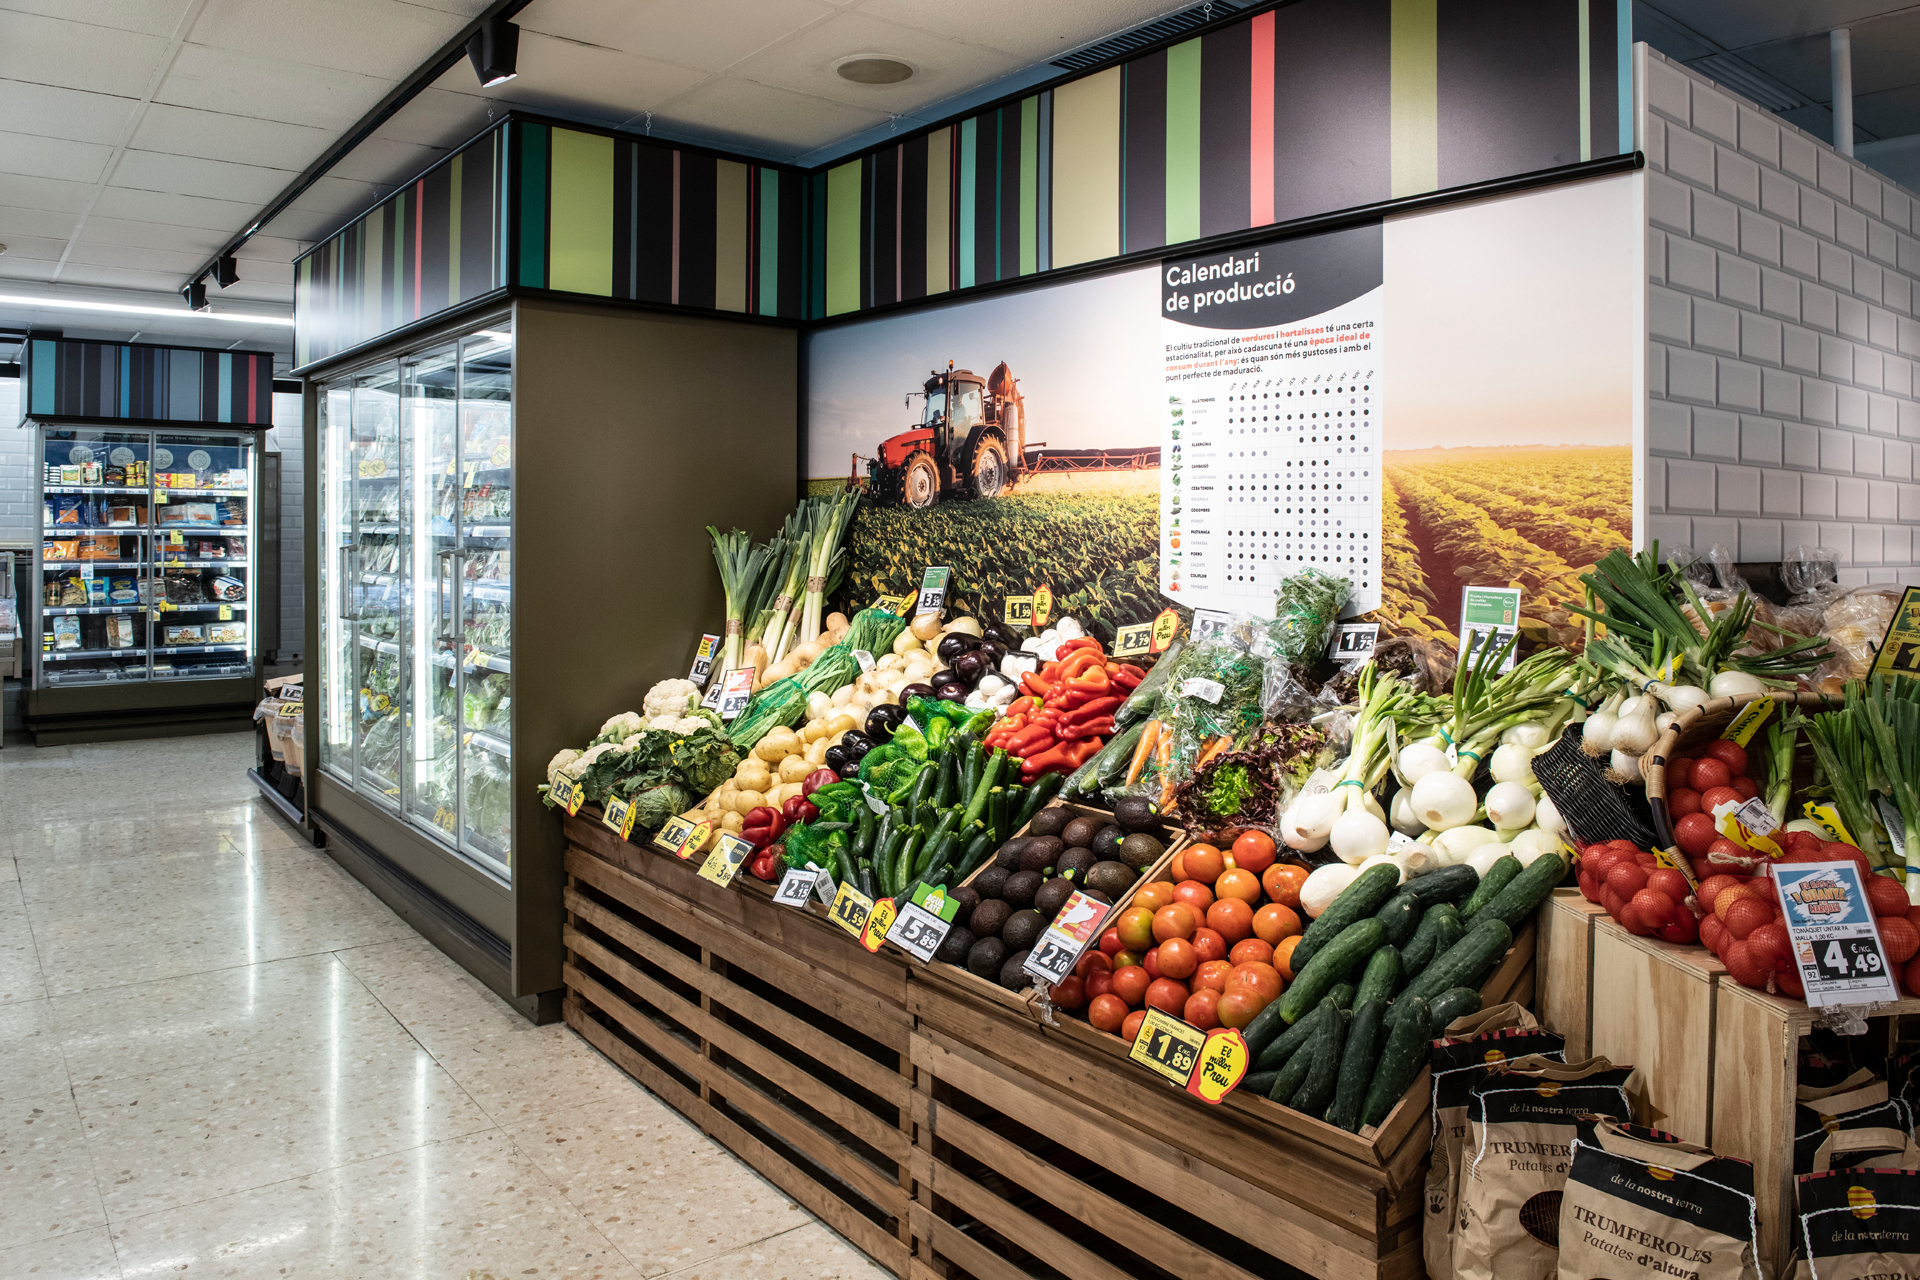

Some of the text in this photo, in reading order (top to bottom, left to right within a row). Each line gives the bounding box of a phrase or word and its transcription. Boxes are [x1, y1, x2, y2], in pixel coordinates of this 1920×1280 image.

[1166, 252, 1259, 287] Calendari
[1166, 272, 1295, 313] de producció
[1165, 344, 1173, 352] El
[1173, 342, 1192, 351] cultiu
[1194, 337, 1230, 348] tradicional
[1231, 336, 1240, 344] de
[1241, 333, 1275, 343] verdures
[1276, 330, 1279, 339] i
[1280, 327, 1324, 338] hortalisses
[1326, 324, 1334, 333] té
[1352, 320, 1374, 329] certa
[1165, 331, 1370, 362] estacionalitat, per això cadascuna té una època ideal de
[1165, 363, 1192, 371] consum
[1194, 360, 1218, 369] durant
[1241, 356, 1249, 364] és
[1250, 355, 1269, 364] quan
[1270, 352, 1284, 361] són
[1285, 350, 1301, 359] més
[1302, 347, 1338, 359] gustoses
[1343, 343, 1362, 353] amb
[1363, 342, 1371, 350] el
[1165, 365, 1263, 383] punt perfecte de maduració.
[1013, 603, 1031, 618] 1,99
[1127, 633, 1149, 648] 2,79
[1156, 632, 1171, 640] Preu
[1345, 633, 1373, 651] 1,75
[785, 880, 809, 898] 2,15
[1801, 887, 1848, 903] GUANYA
[924, 901, 940, 917] CATE
[927, 893, 945, 909] AGUA
[843, 900, 864, 927] 1,59
[880, 910, 888, 918] El
[869, 921, 885, 940] Preu
[904, 920, 937, 949] 5,89
[1793, 926, 1823, 934] TOMÀQUET
[1851, 943, 1872, 954] €/KG.
[1040, 944, 1068, 973] 2,10
[1823, 940, 1881, 977] 4,49
[1807, 971, 1817, 979] 92
[1158, 1034, 1191, 1071] 1,89
[1221, 1045, 1232, 1058] El
[1208, 1055, 1231, 1072] millor
[1203, 1062, 1229, 1087] Preu
[1510, 1103, 1520, 1113] de
[1532, 1105, 1563, 1115] nostra
[1566, 1105, 1589, 1116] terra
[1510, 1160, 1553, 1173] Patates
[1610, 1173, 1703, 1215] de la nostra terra
[1574, 1204, 1713, 1264] TRUMFEROLES
[1831, 1229, 1910, 1242] de la terra
[1583, 1230, 1700, 1280] Patates d'altura
